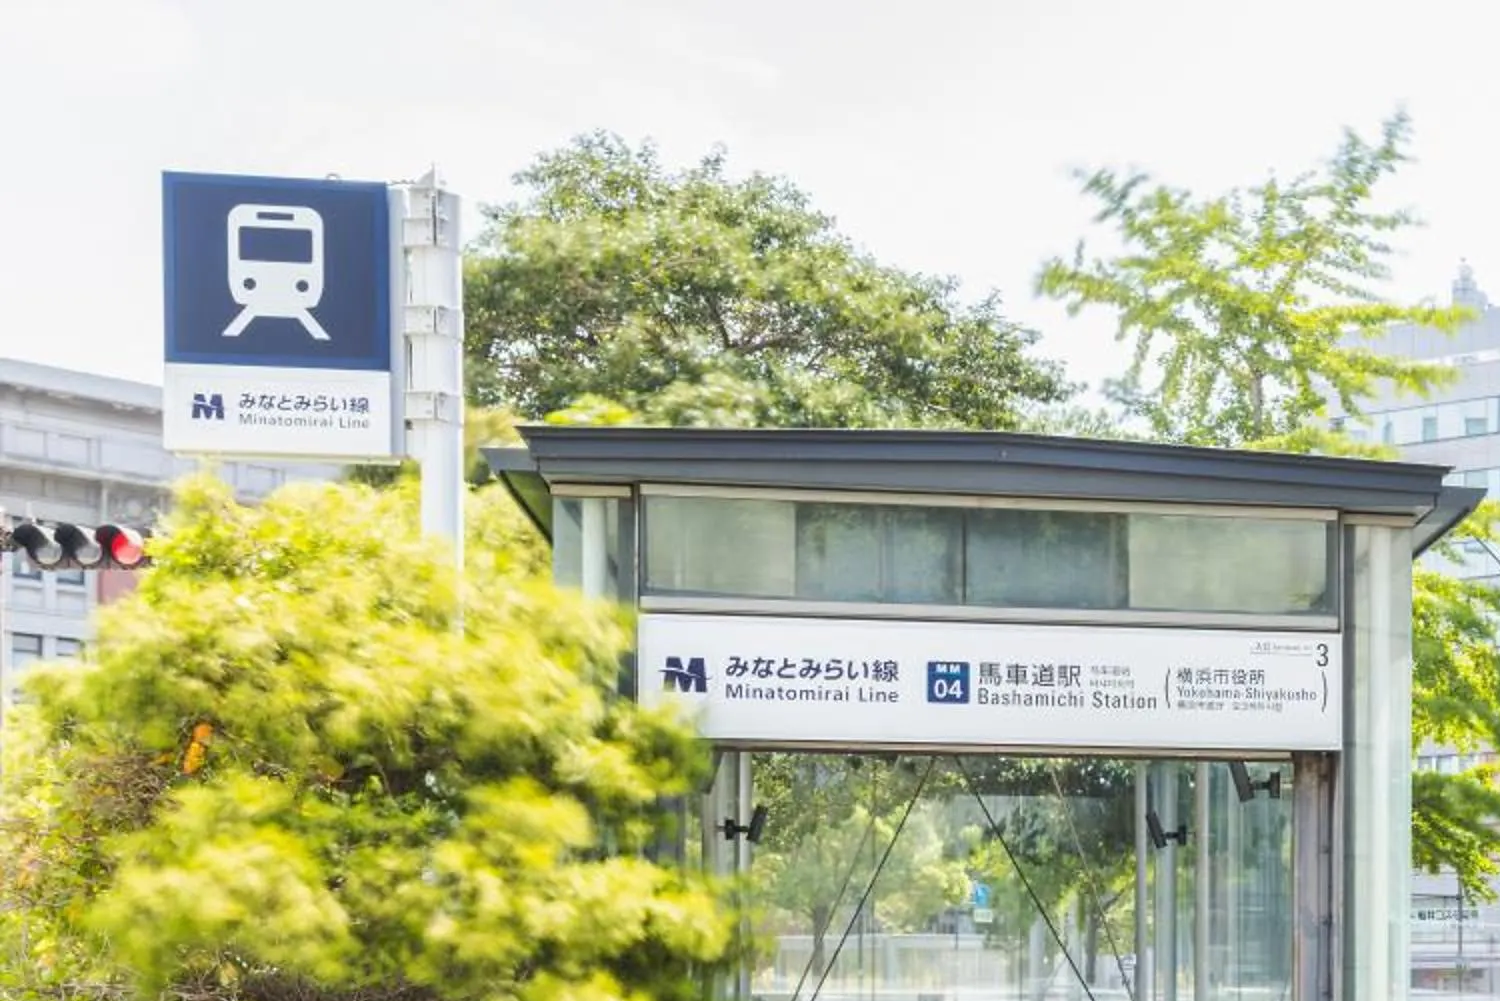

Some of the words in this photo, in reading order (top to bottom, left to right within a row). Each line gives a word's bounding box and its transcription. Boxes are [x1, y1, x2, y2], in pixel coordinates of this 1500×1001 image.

[239, 393, 370, 414] みなとみらい線
[239, 413, 333, 428] Minatomirai
[339, 417, 370, 429] Line
[1317, 643, 1329, 667] 3
[725, 656, 899, 683] みなとみらい線
[935, 664, 961, 673] MM
[979, 662, 1081, 688] 馬車道駅
[1177, 668, 1265, 685] 横浜市役所
[725, 683, 850, 701] Minatomirai
[858, 687, 899, 703] Line
[934, 680, 963, 699] 04
[978, 687, 1085, 708] Bashamichi
[1092, 690, 1157, 709] Station
